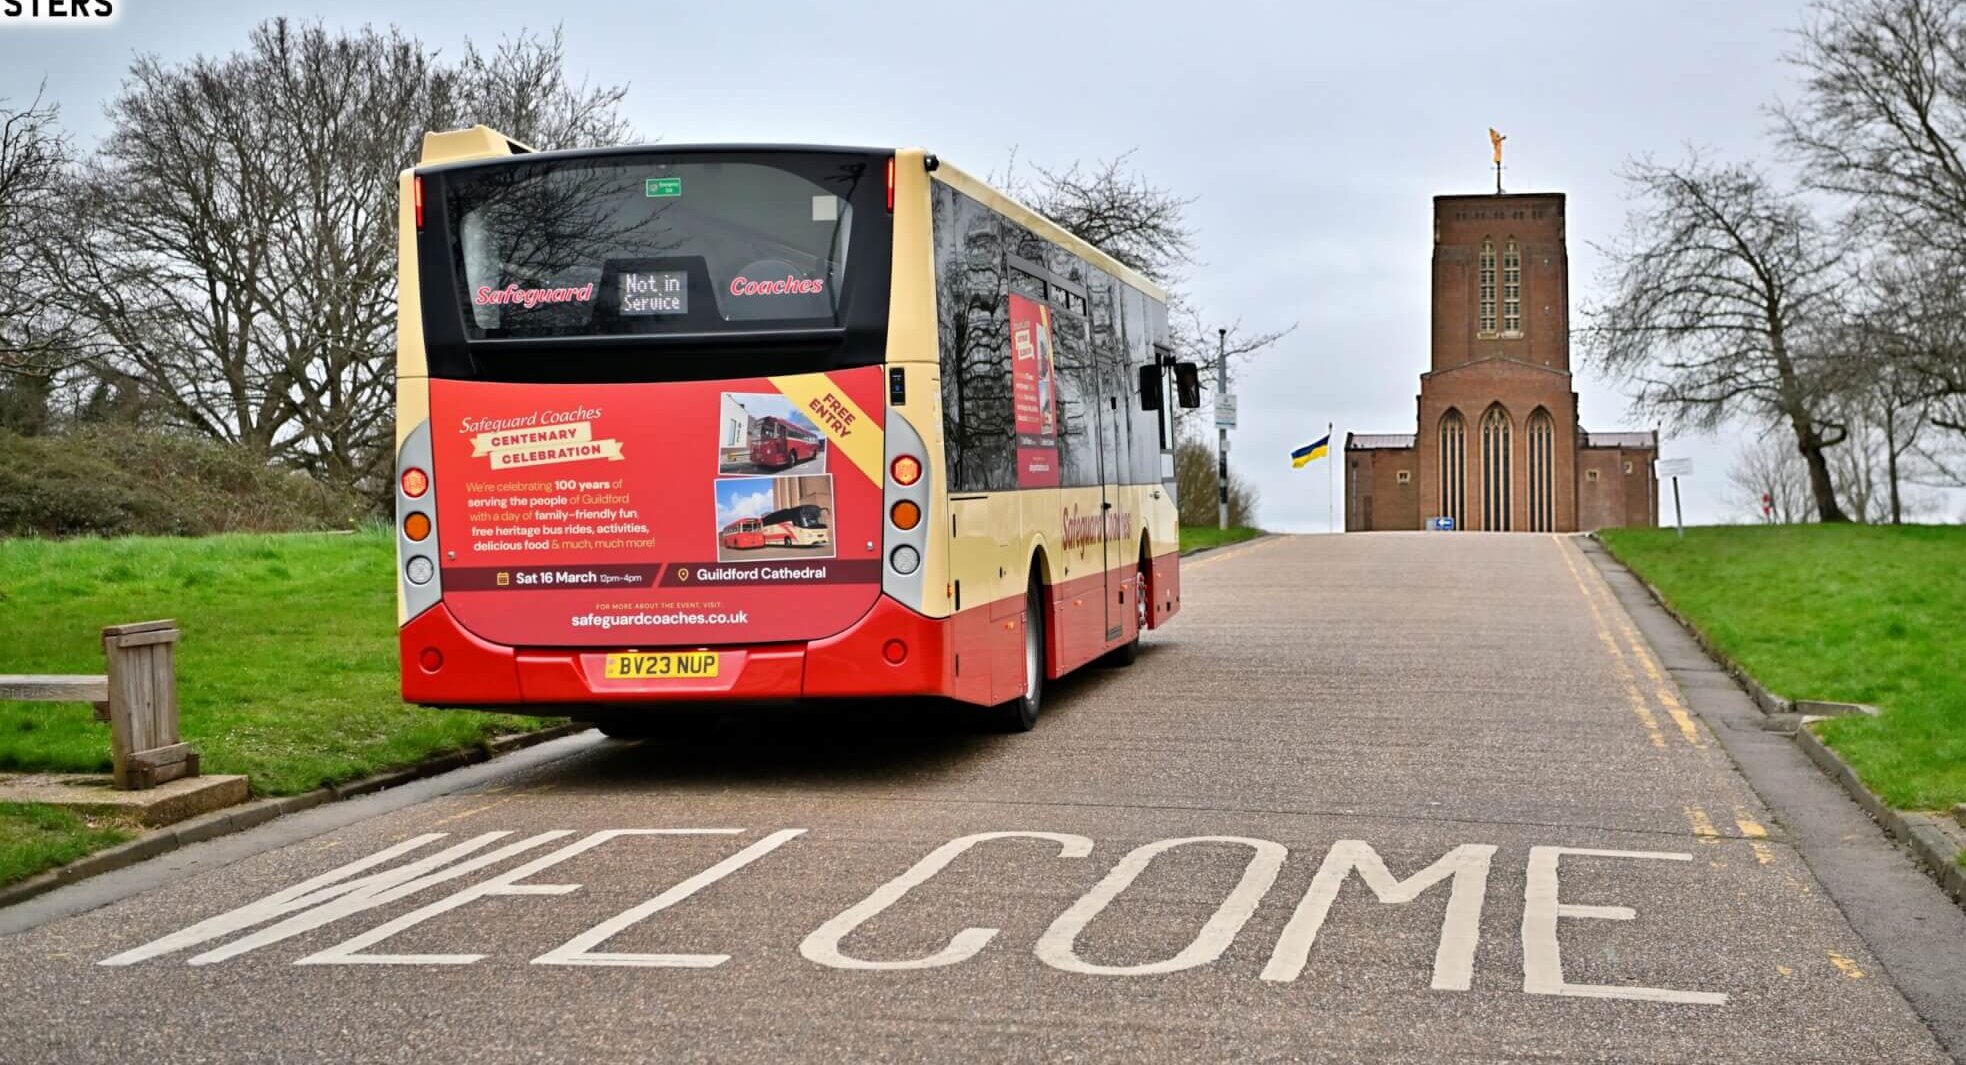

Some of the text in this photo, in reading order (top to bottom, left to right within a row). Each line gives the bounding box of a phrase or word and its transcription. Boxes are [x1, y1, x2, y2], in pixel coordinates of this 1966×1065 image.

[626, 273, 680, 292] Not in
[730, 274, 824, 296] Coaches
[475, 282, 594, 309] Safeguard
[624, 293, 680, 311] Service
[808, 398, 852, 438] ENTRY
[822, 392, 856, 426] FREE
[459, 405, 602, 433] Safeguard Coaches
[491, 428, 577, 447] CENTENARY
[502, 444, 601, 464] CELEBRATION
[466, 478, 623, 493] We're celebrating 100 years of
[468, 492, 630, 509] serving the people of Guildford
[470, 511, 491, 522] with
[501, 511, 520, 523] day
[522, 510, 532, 521] of
[535, 508, 617, 523] family-friendly
[472, 522, 650, 538] free heritage bus rides, activities,
[473, 536, 655, 551] delicious food & much, much more!
[516, 572, 538, 584] Sat
[540, 571, 553, 584] 16
[555, 570, 597, 583] March
[697, 566, 826, 581] Guildford Cathedral
[635, 602, 658, 610] ABOUT
[571, 610, 748, 629] safeguardcoaches.co.uk
[620, 655, 716, 675] BV23 NUP
[97, 828, 1729, 1006] WELCOME
